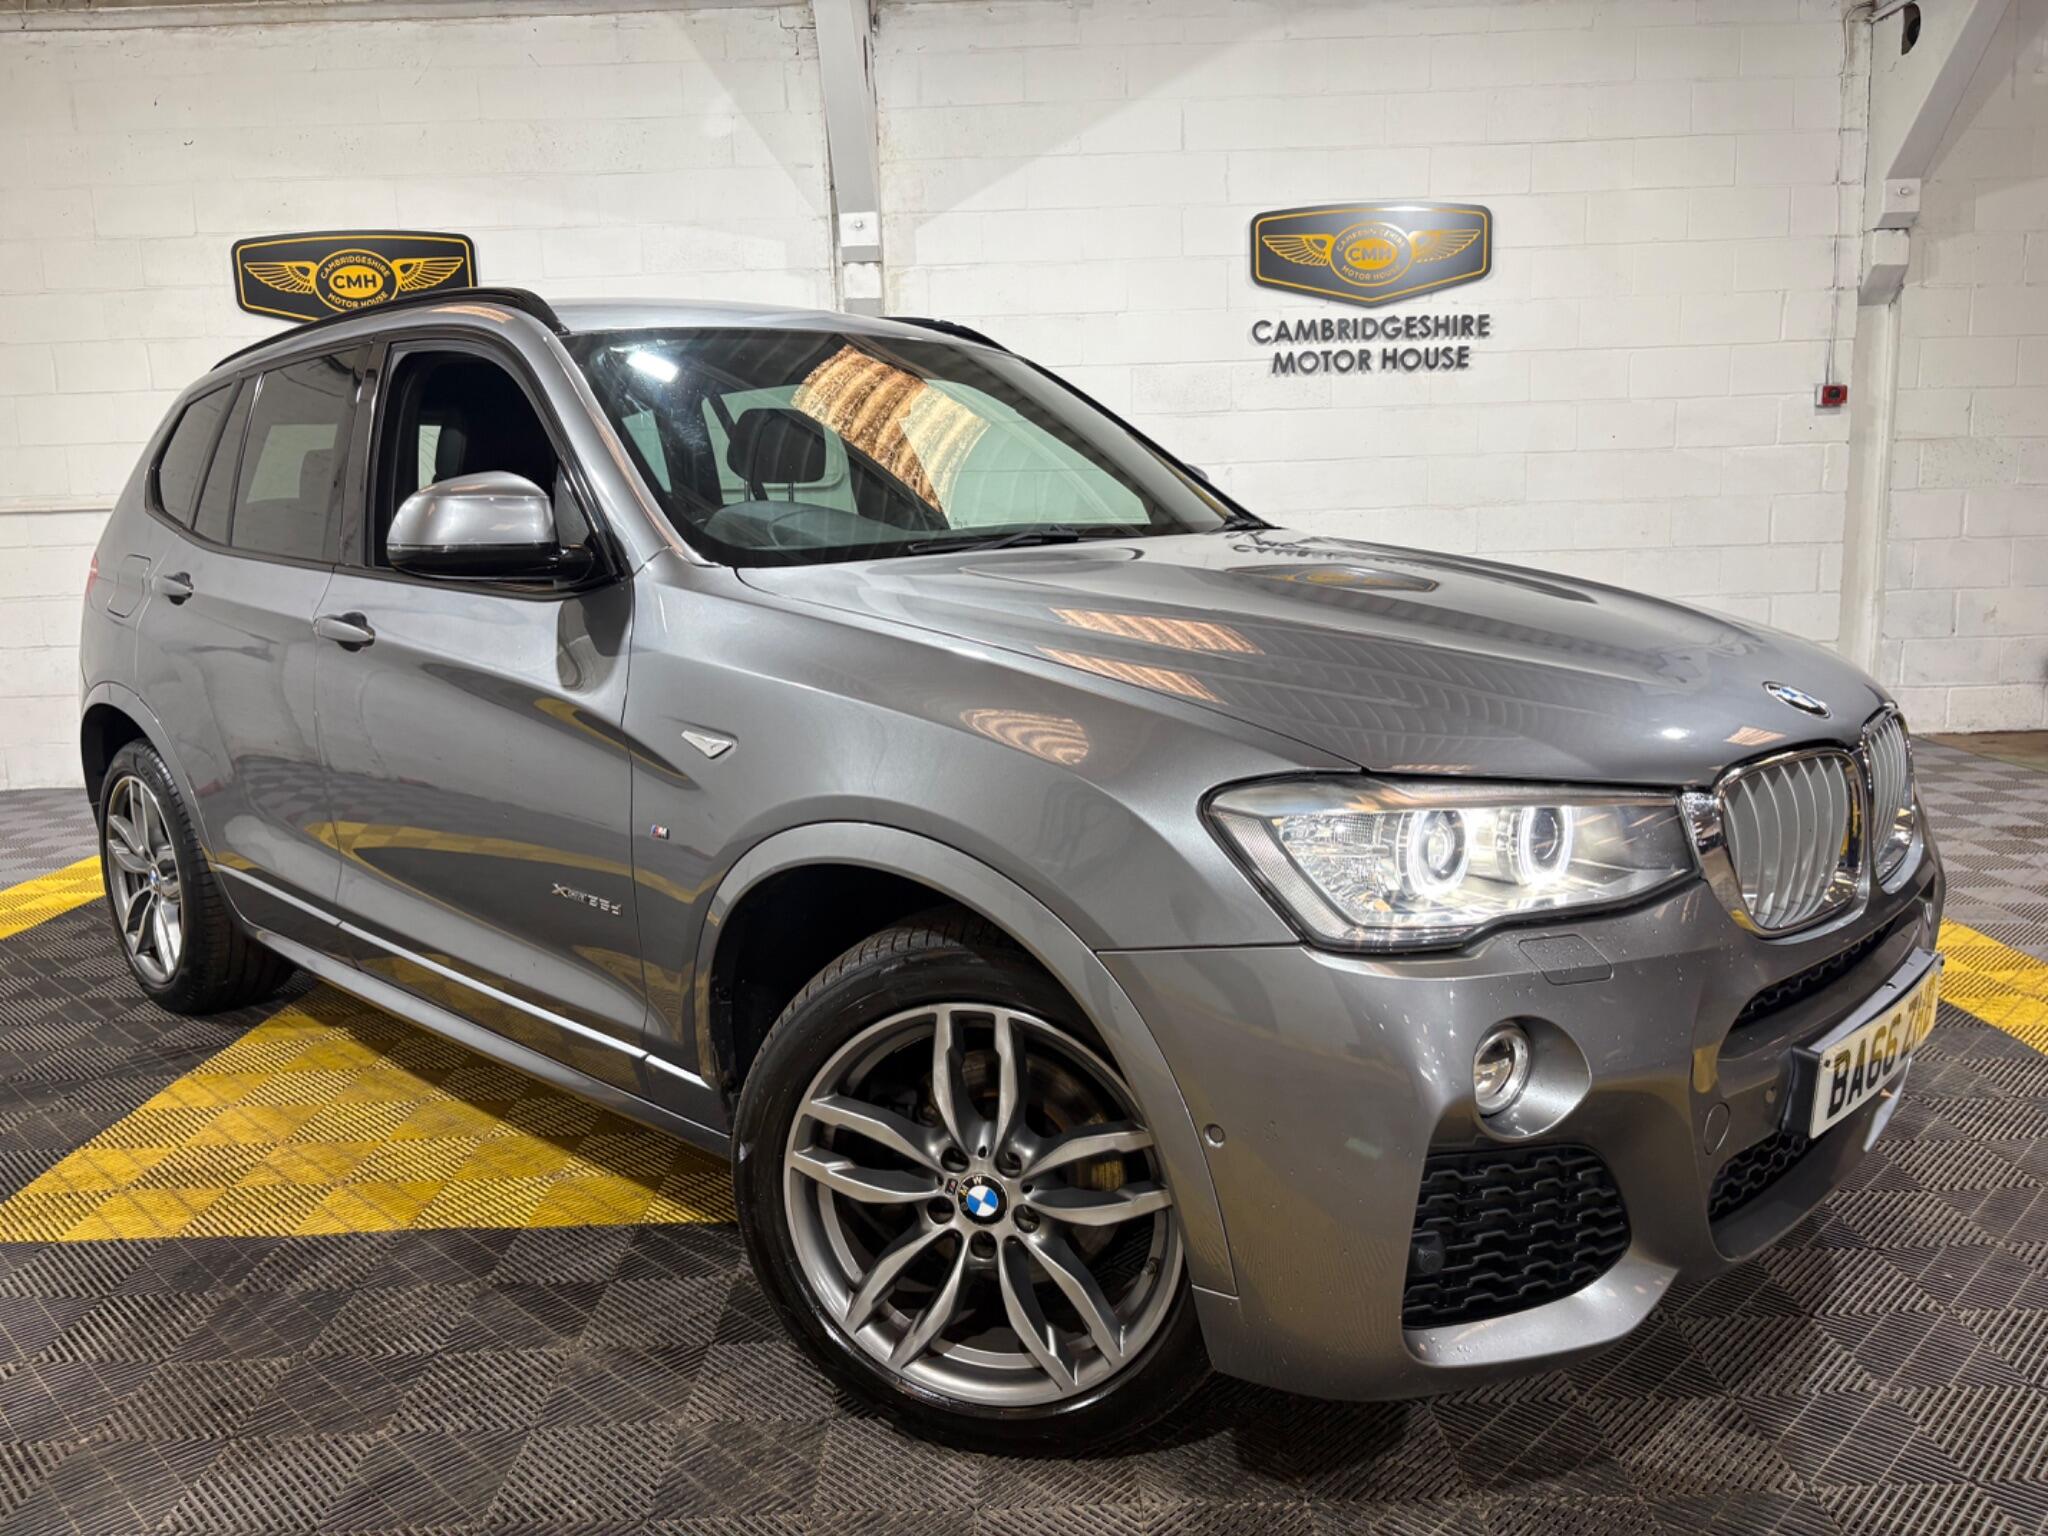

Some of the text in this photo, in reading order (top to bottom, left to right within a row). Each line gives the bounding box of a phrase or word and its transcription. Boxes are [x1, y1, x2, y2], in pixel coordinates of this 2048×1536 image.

[1336, 228, 1405, 252] CAMBRSHIRE
[1348, 247, 1391, 261] CMH
[321, 256, 390, 278] CAMBRIDGESHIRE
[1341, 264, 1371, 281] MOTOR
[333, 274, 377, 289] CMH
[328, 291, 388, 308] MOTOR HOUSE
[1251, 314, 1490, 344] CAMBRIDGESHIRE
[1272, 346, 1470, 374] MOTOR HOUSE
[1827, 1013, 1902, 1119] BA66
